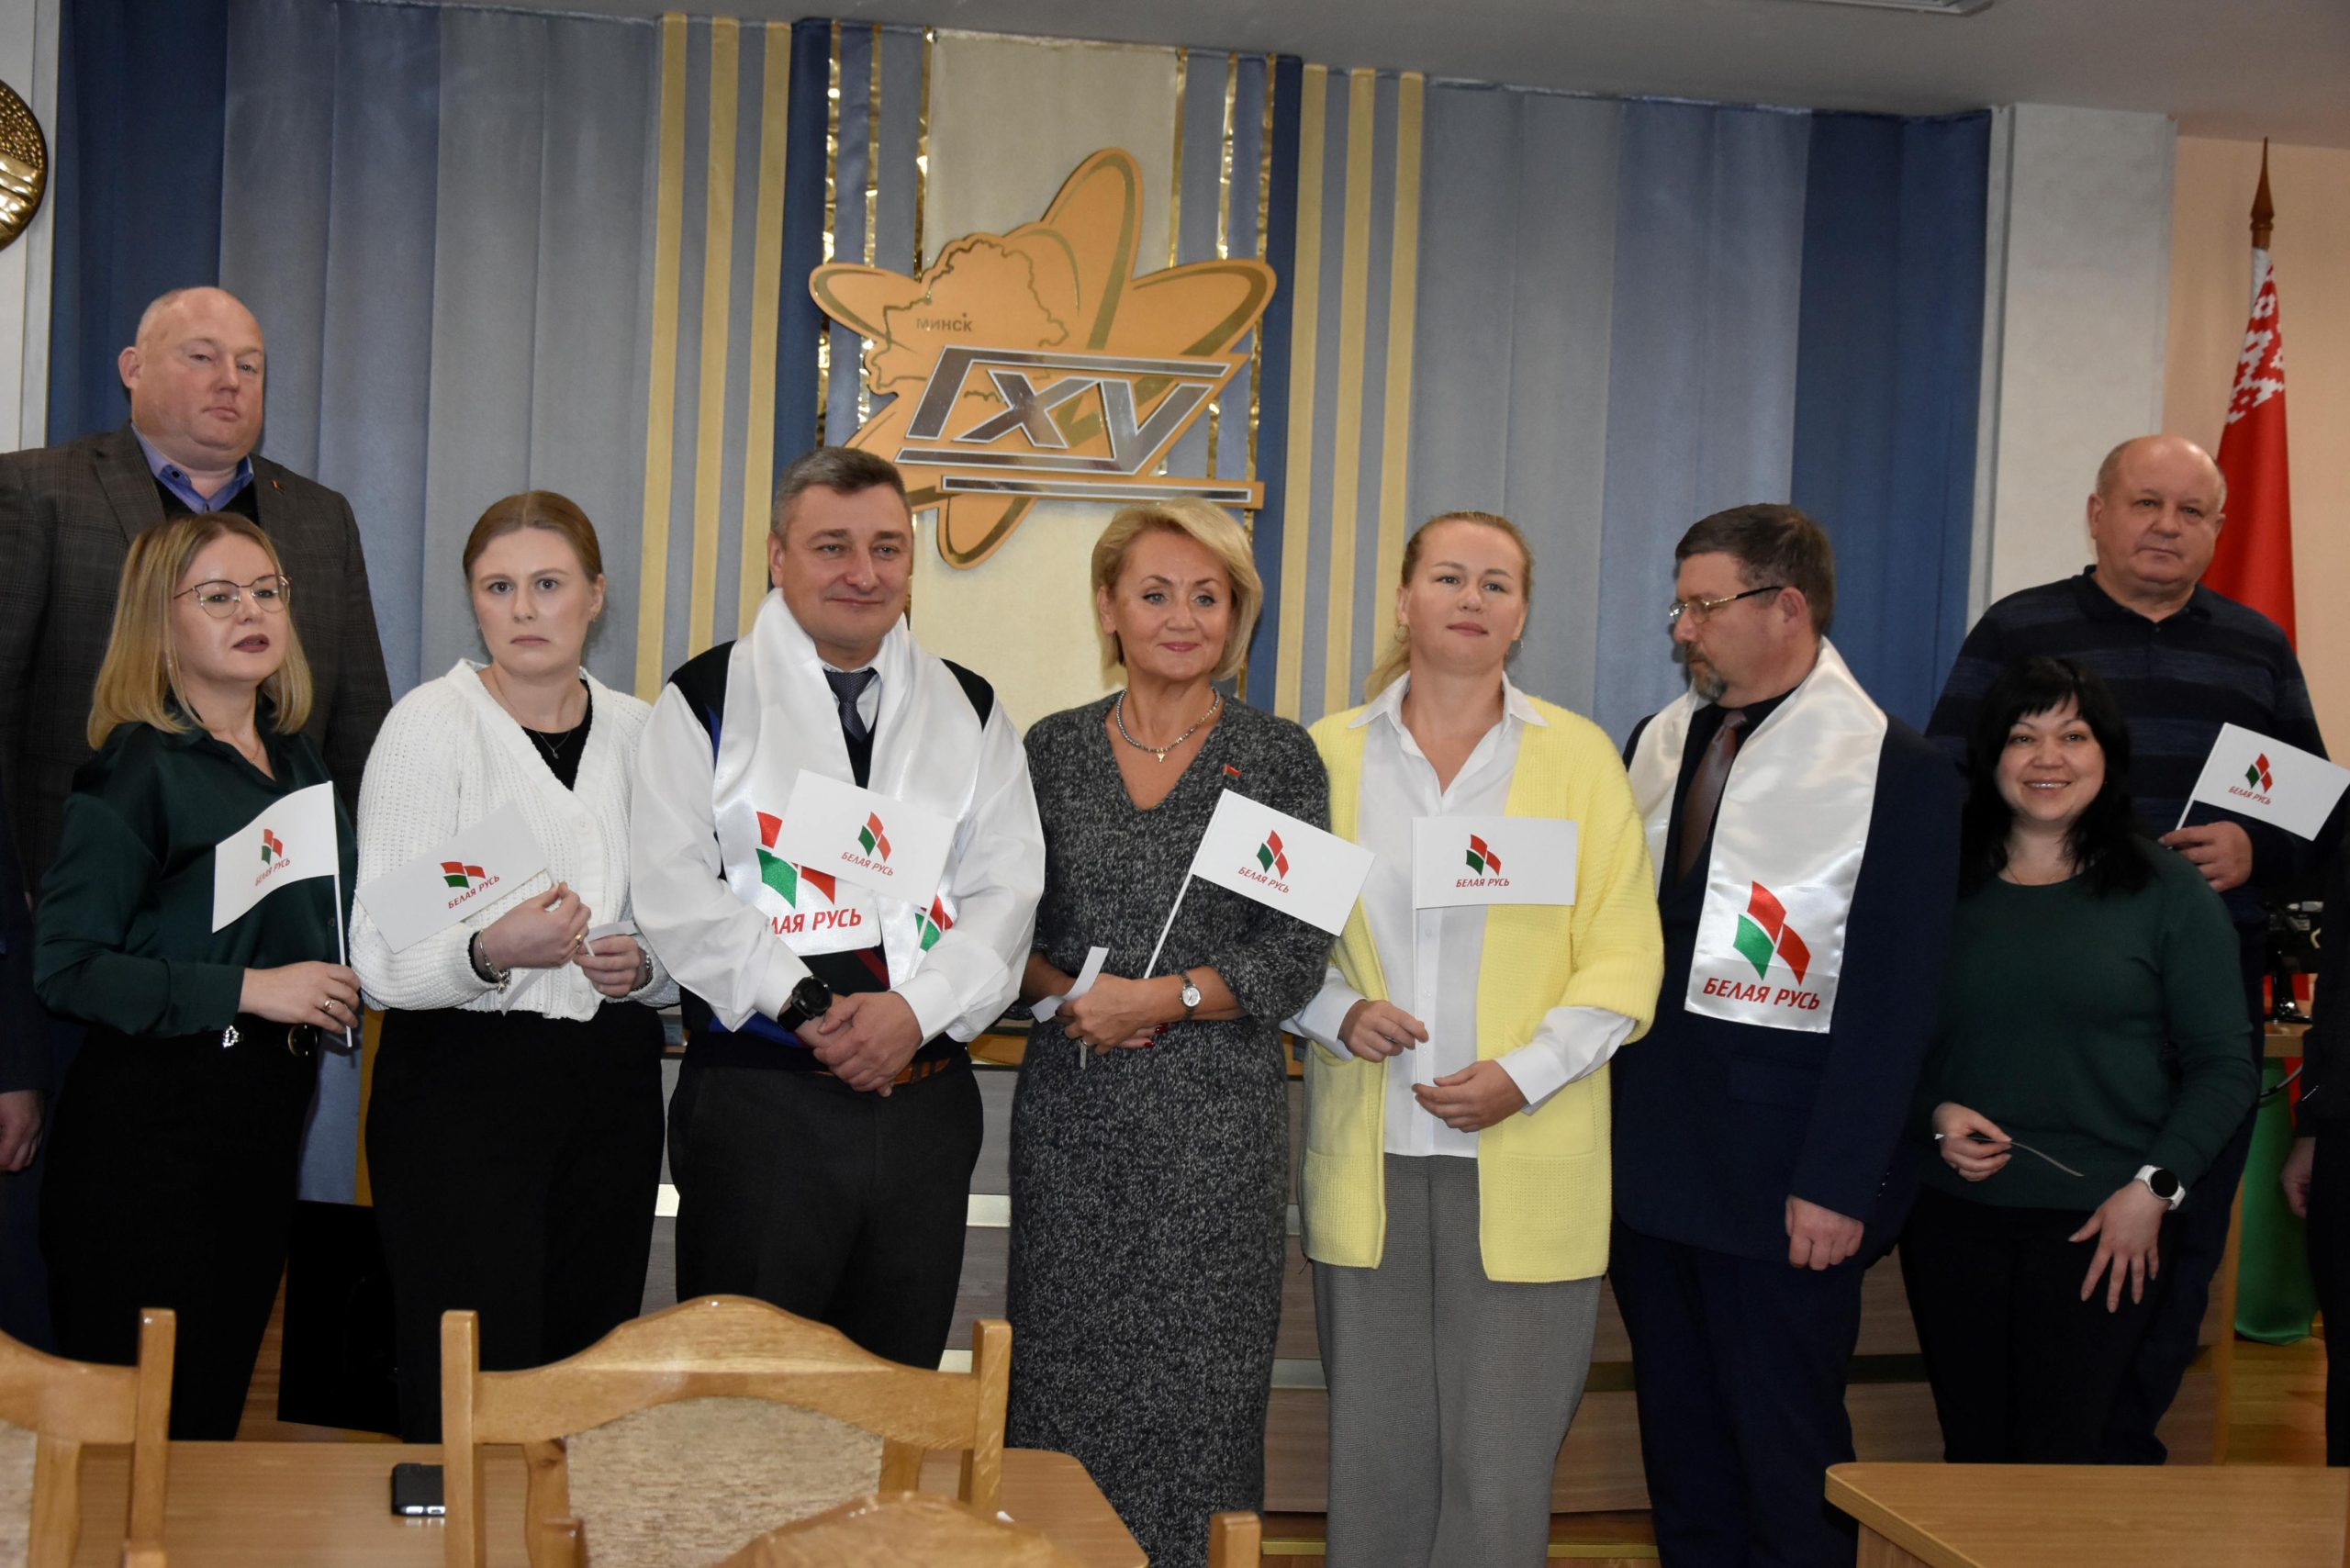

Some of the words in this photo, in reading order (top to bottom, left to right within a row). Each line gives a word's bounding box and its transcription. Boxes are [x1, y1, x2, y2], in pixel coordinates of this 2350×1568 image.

[916, 319, 972, 331] МИНСК
[841, 851, 871, 868] БЕЛАЯ
[871, 862, 894, 876] РУСЬ
[448, 888, 476, 909] БЕЛАЯ
[478, 875, 500, 891] РУСЬ
[1237, 867, 1268, 883] БЕЛАЯ
[1267, 879, 1290, 893] РУСЬ
[1455, 879, 1485, 888] БЕЛАЯ
[1487, 879, 1510, 887] РУСЬ
[812, 908, 862, 931] РУСЬ
[1703, 978, 1771, 1002] БЕЛАЯ
[1774, 989, 1820, 1010] РУСЬ
